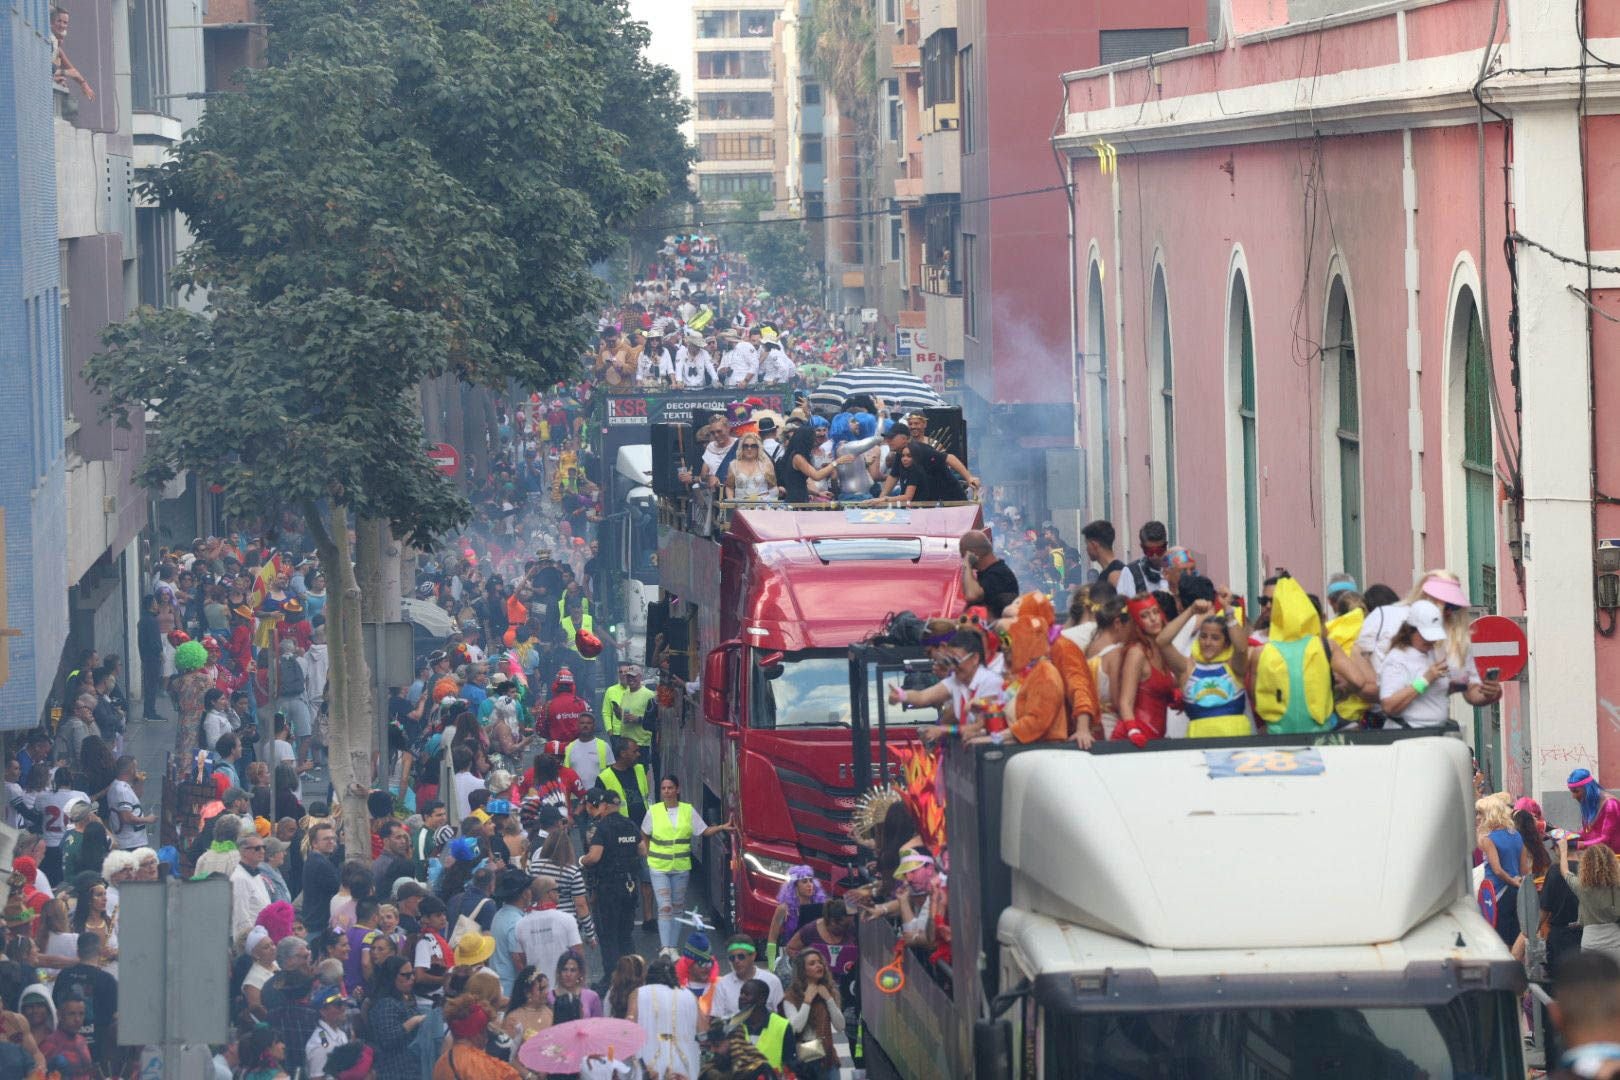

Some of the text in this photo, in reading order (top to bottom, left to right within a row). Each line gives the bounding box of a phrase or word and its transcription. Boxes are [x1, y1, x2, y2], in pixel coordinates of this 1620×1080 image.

[610, 399, 648, 416] KSR
[666, 401, 725, 410] DECORACIÓN
[1231, 752, 1298, 772] 28
